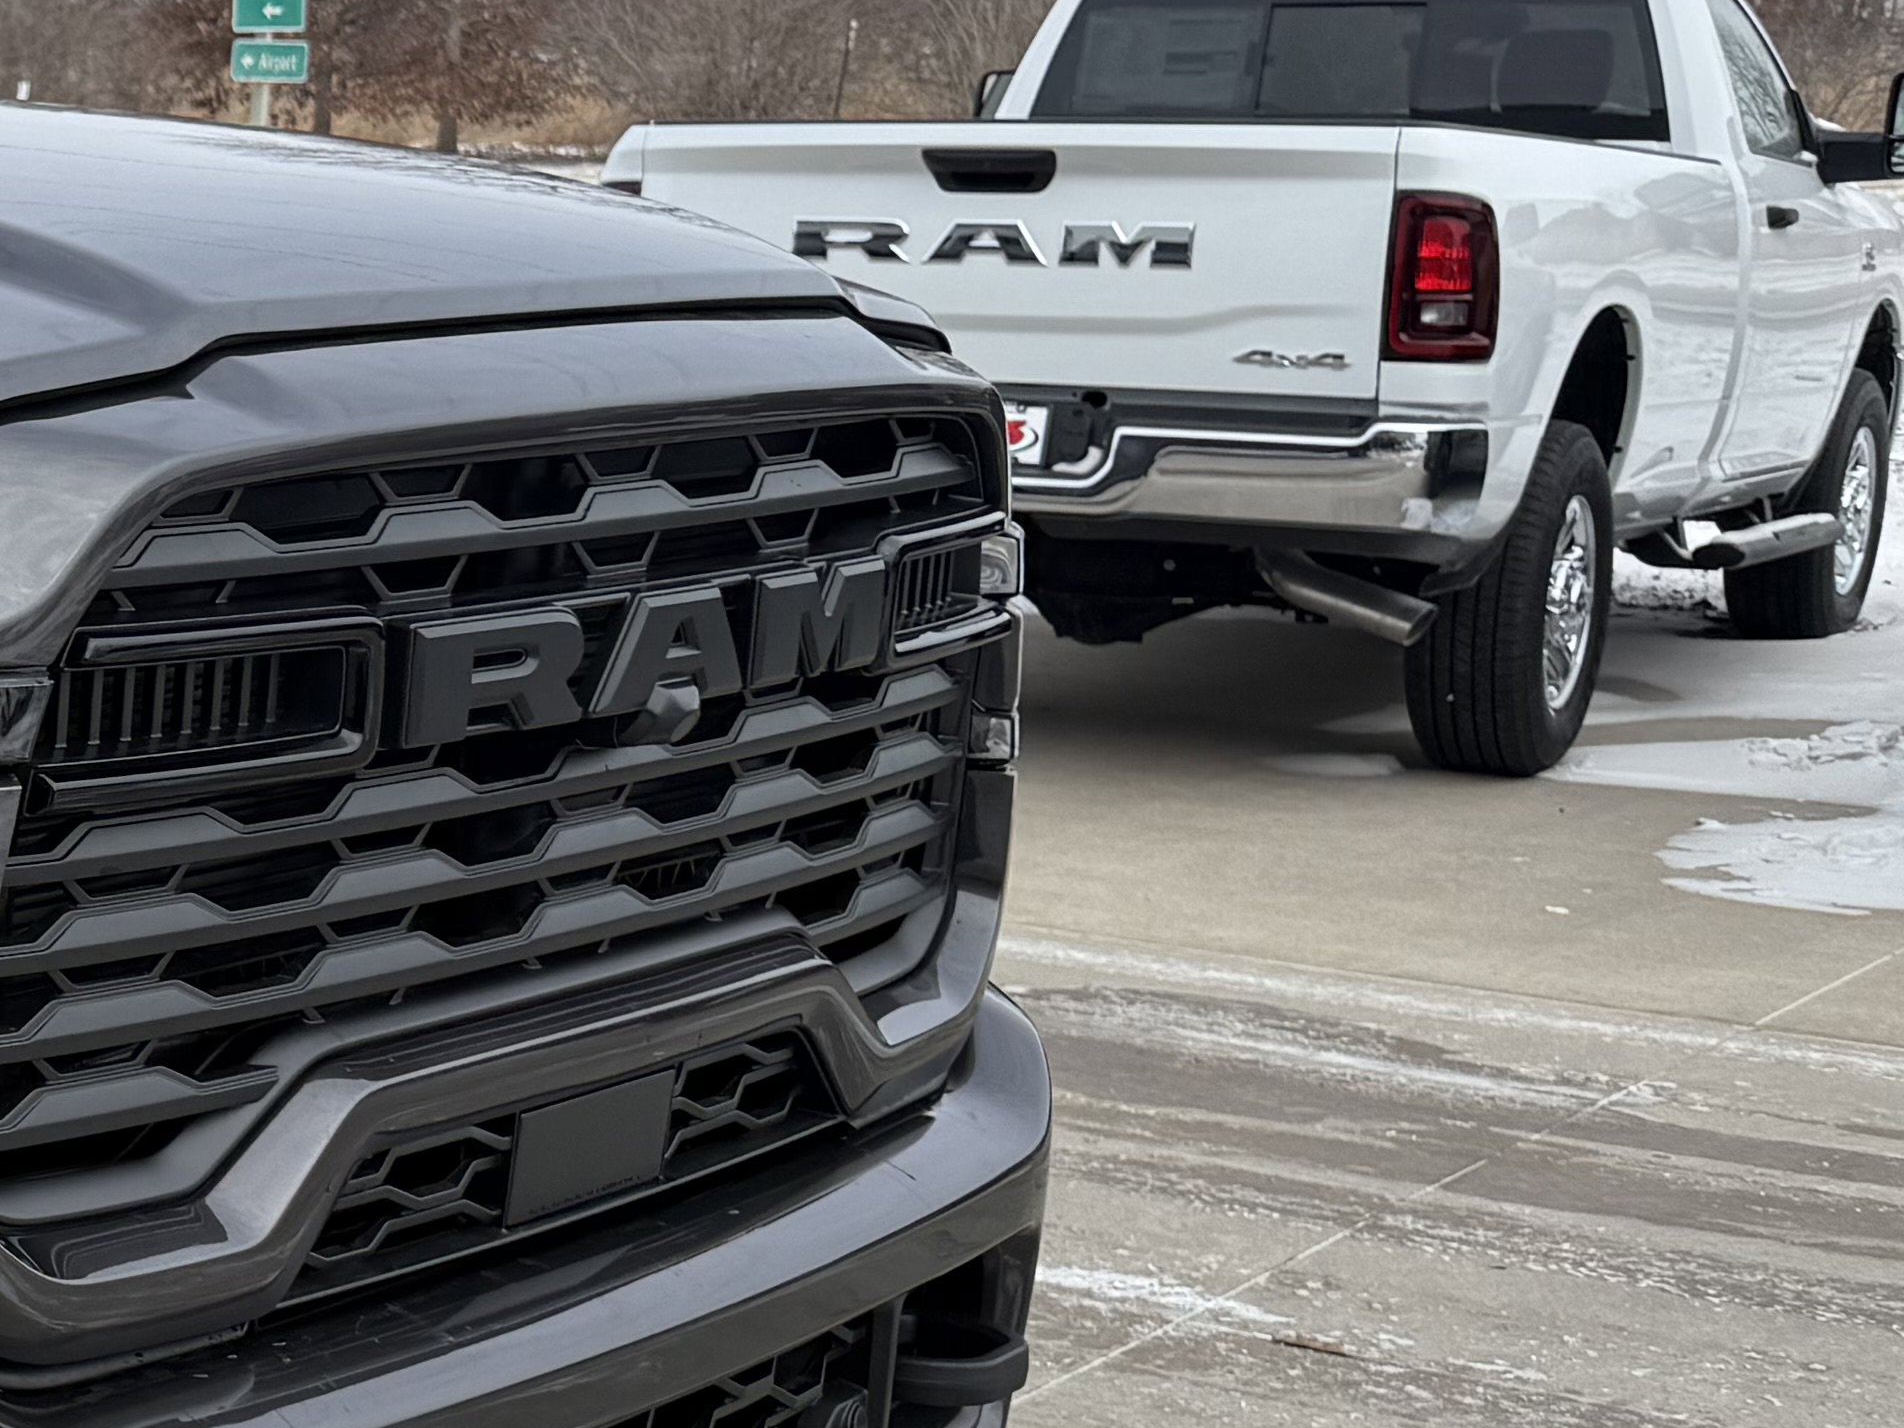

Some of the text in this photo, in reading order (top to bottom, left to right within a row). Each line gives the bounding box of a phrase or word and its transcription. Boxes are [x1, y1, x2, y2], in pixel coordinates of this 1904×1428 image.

[257, 52, 298, 74] Airport
[791, 218, 1198, 270] RAM
[401, 552, 891, 747] RAM
